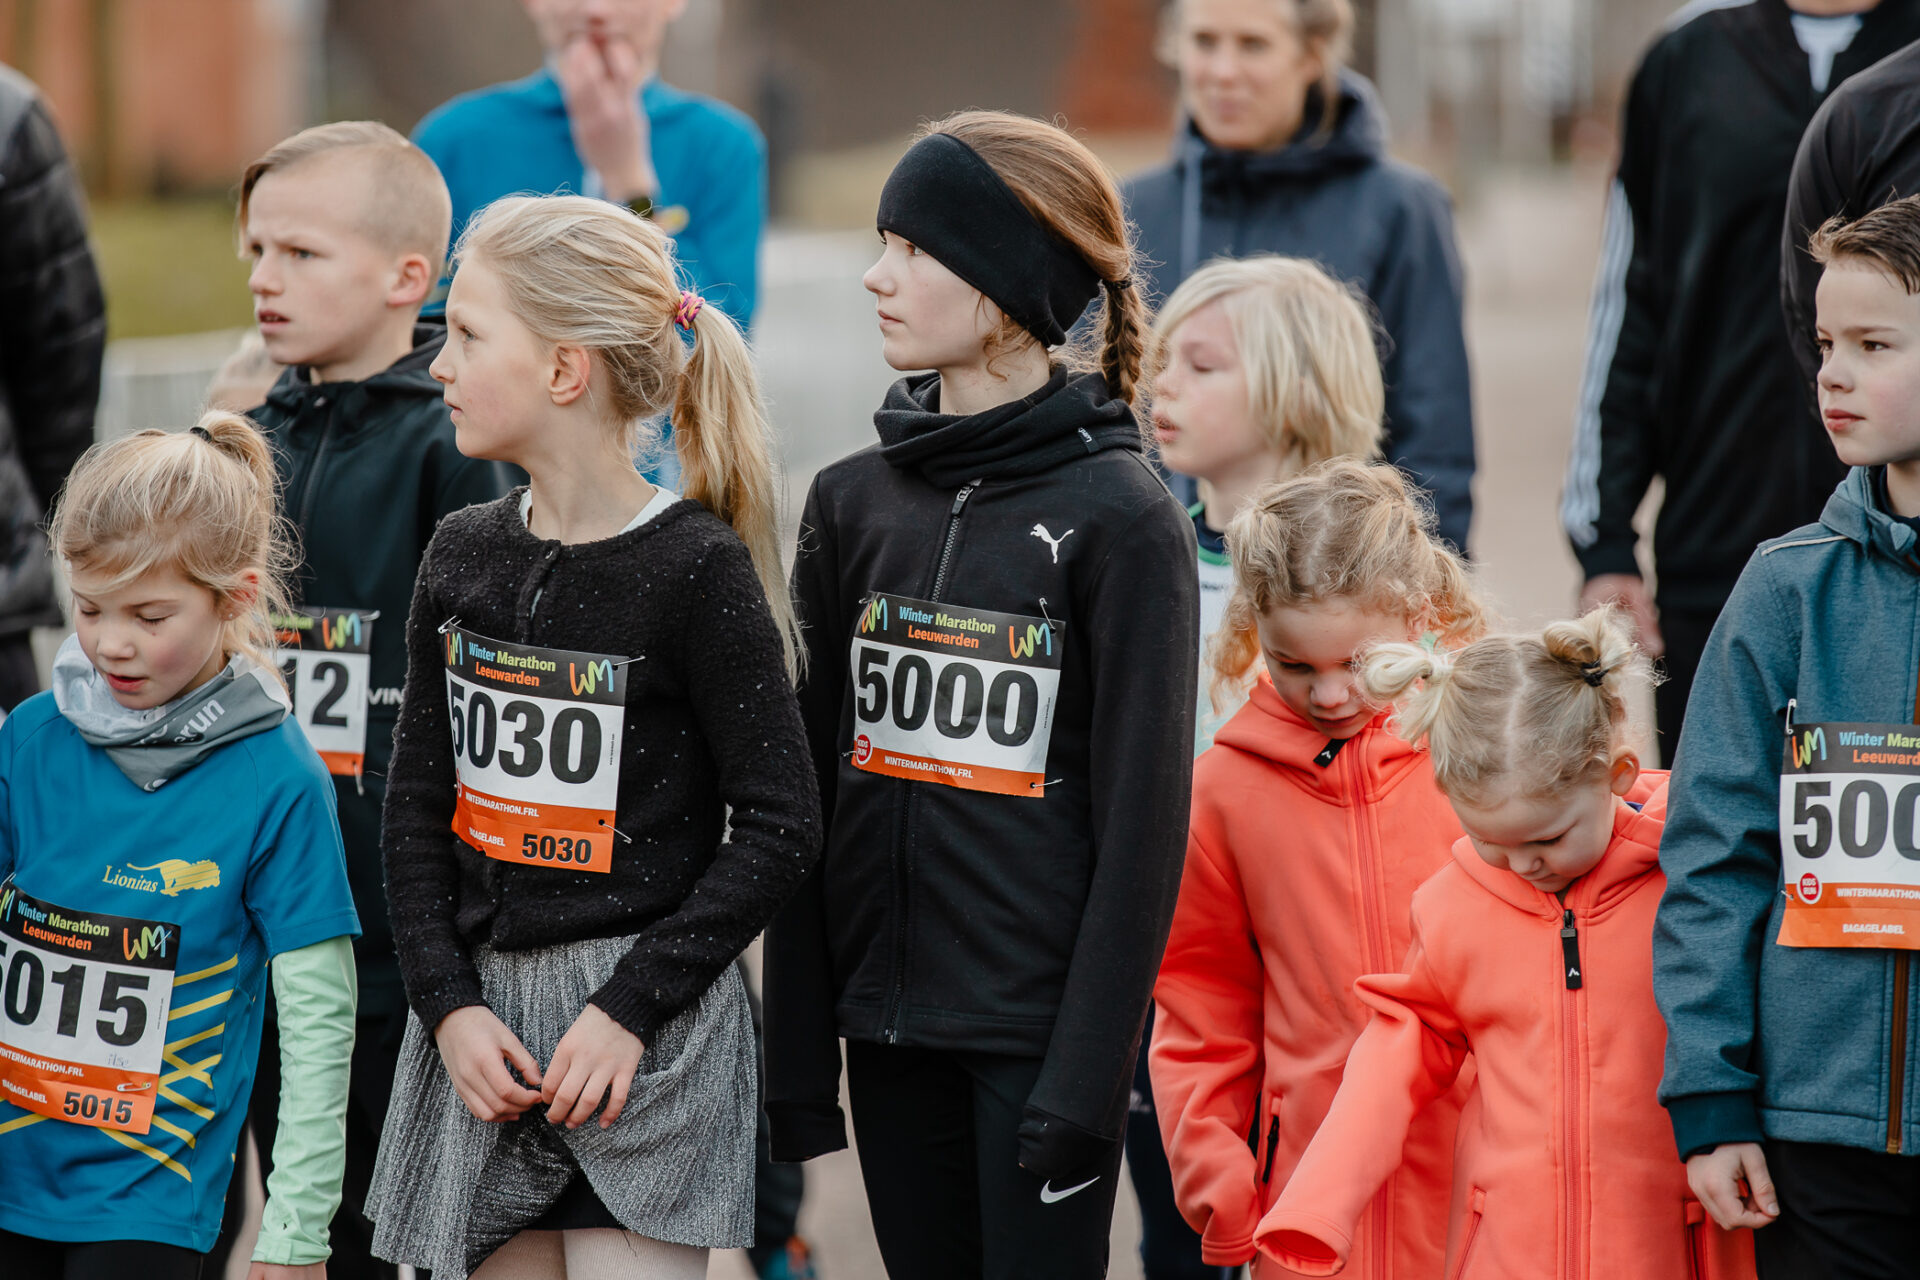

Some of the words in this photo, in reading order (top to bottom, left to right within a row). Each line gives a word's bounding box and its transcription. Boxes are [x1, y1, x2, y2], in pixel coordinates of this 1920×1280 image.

[899, 606, 933, 625] Winter
[935, 612, 997, 635] Marathon
[907, 625, 980, 649] Leeuwarden
[468, 641, 495, 662] Winter
[497, 650, 556, 672] Marathon
[475, 661, 540, 687] Leeuwarden
[856, 645, 1039, 748] 5000
[450, 681, 602, 785] 5030
[1838, 731, 1885, 746] Winter
[884, 755, 974, 779] WINTERMARATHON.FRL
[521, 833, 592, 865] 5030
[102, 865, 159, 893] Lionitas
[17, 899, 47, 923] Winter
[48, 912, 110, 937] Marathon
[1842, 923, 1905, 935] BAGAGELABEL
[23, 920, 92, 951] Leeuwarden
[63, 1091, 133, 1126] 5015
